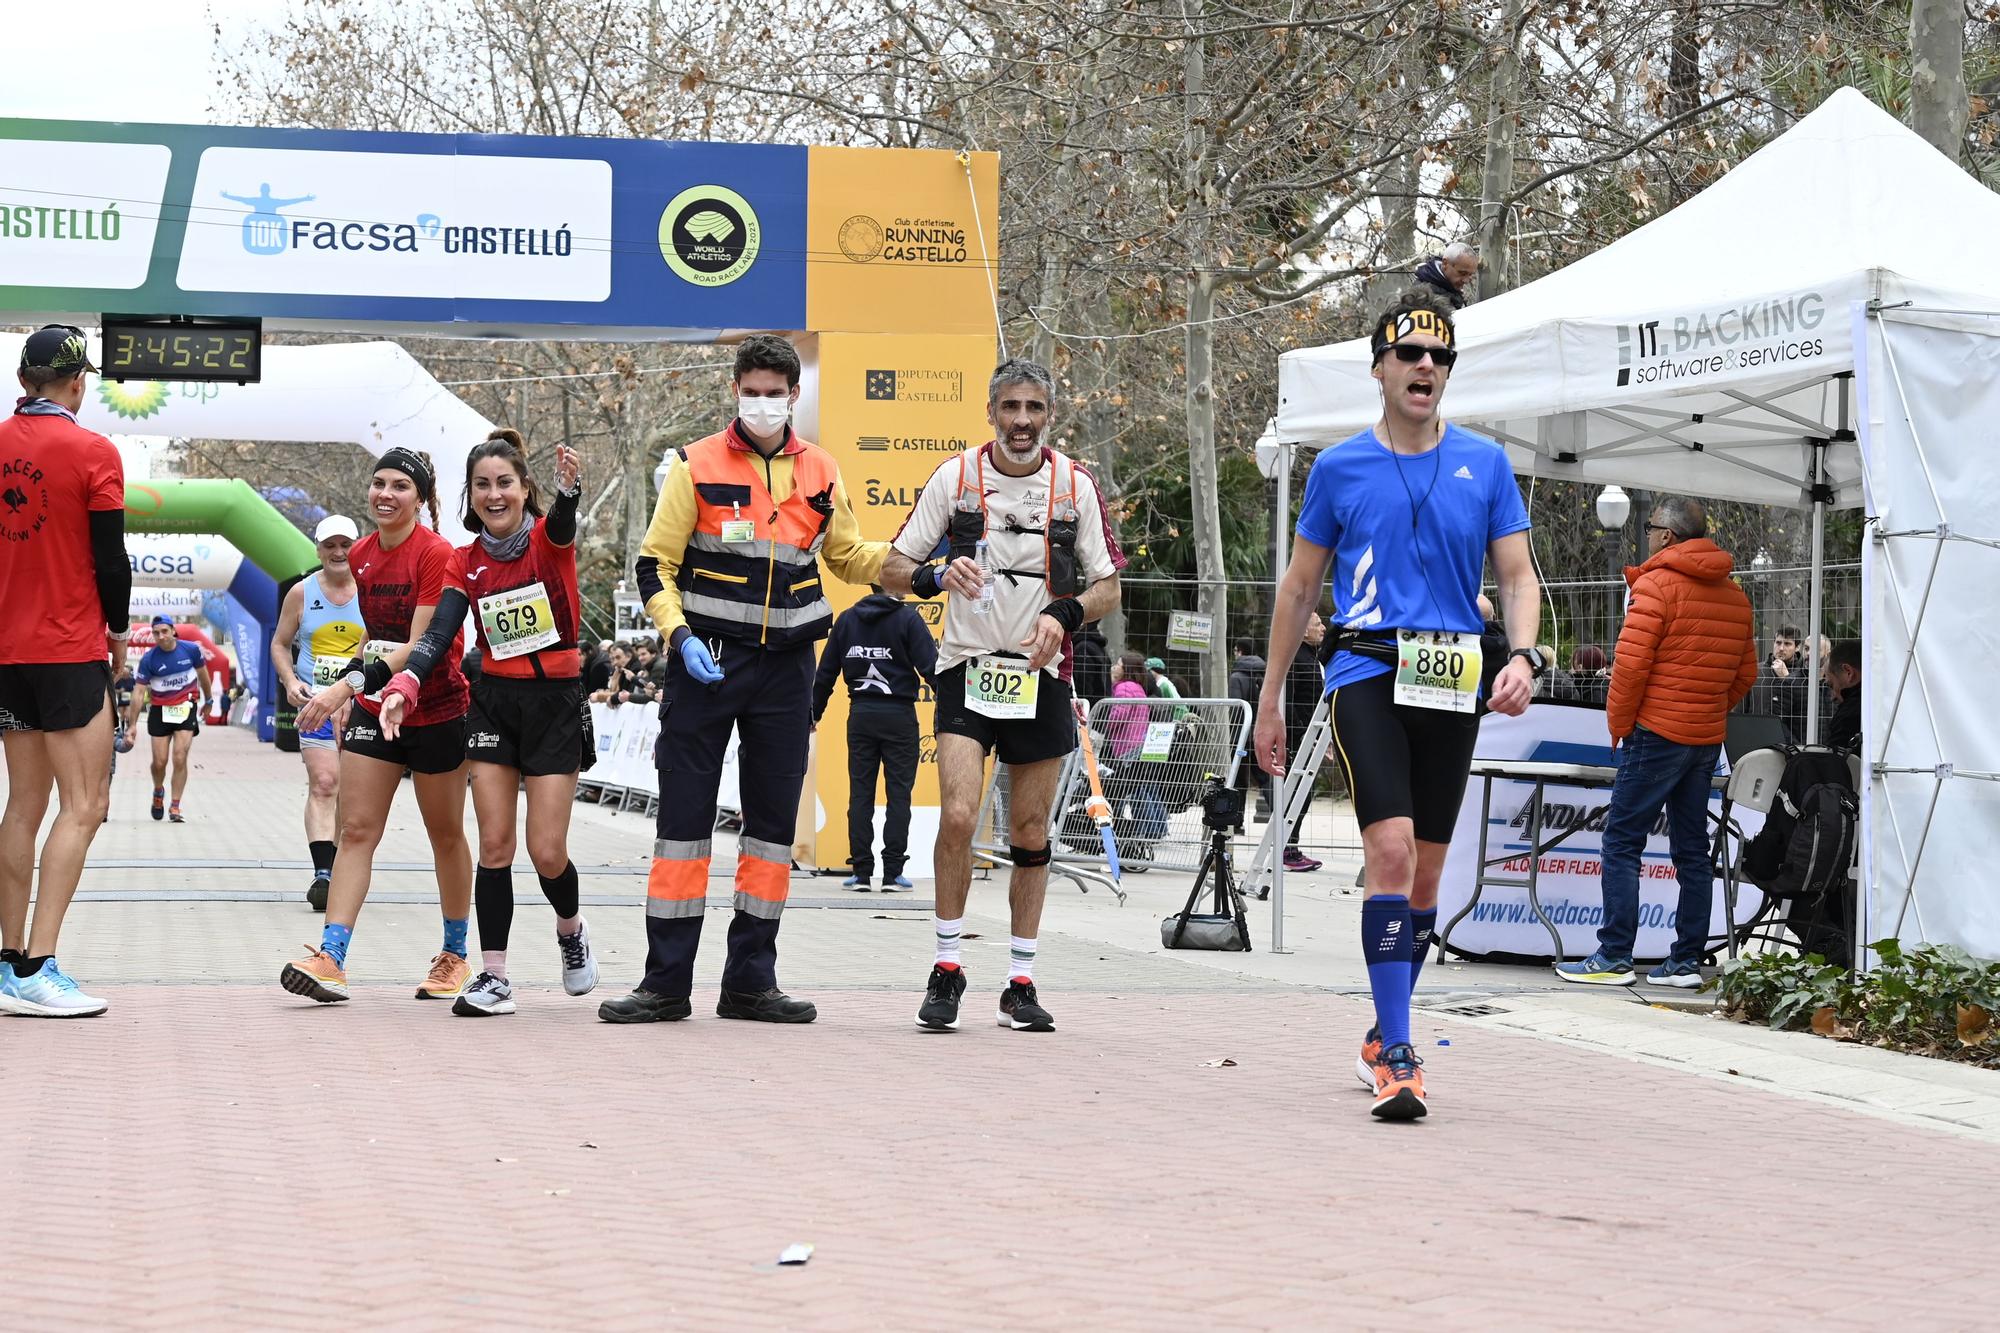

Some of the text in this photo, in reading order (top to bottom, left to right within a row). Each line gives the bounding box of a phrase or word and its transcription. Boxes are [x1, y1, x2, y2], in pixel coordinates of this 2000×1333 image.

[0, 202, 120, 241] ASTELLÓ
[894, 218, 955, 227] Club d'atletisme
[250, 221, 571, 257] 10K Facsa CASTELLÓ
[885, 228, 965, 244] RUNNING
[687, 253, 732, 261] ATHLETICS
[693, 222, 757, 283] ROAD RACE LABEL 2023
[694, 245, 725, 254] WORLD
[884, 243, 967, 262] CASTELLÓ
[114, 335, 251, 368] 3:45:22
[1636, 336, 1824, 385] software&services
[897, 369, 959, 380] DIPUTACIÓ
[897, 392, 959, 402] CASTELLÓ
[894, 437, 967, 451] CASTELLÓN
[3, 459, 44, 485] ACER
[0, 523, 29, 542] LLOW
[129, 554, 194, 575] acsa
[131, 589, 199, 607] aixaBank
[496, 605, 537, 633] 679
[503, 627, 540, 642] SANDRA
[1416, 648, 1464, 679] 880
[979, 672, 1022, 696] 802
[1415, 675, 1460, 689] ENRIQUE
[981, 694, 1017, 704] LLEGUE
[1503, 857, 1566, 874] ALQILER
